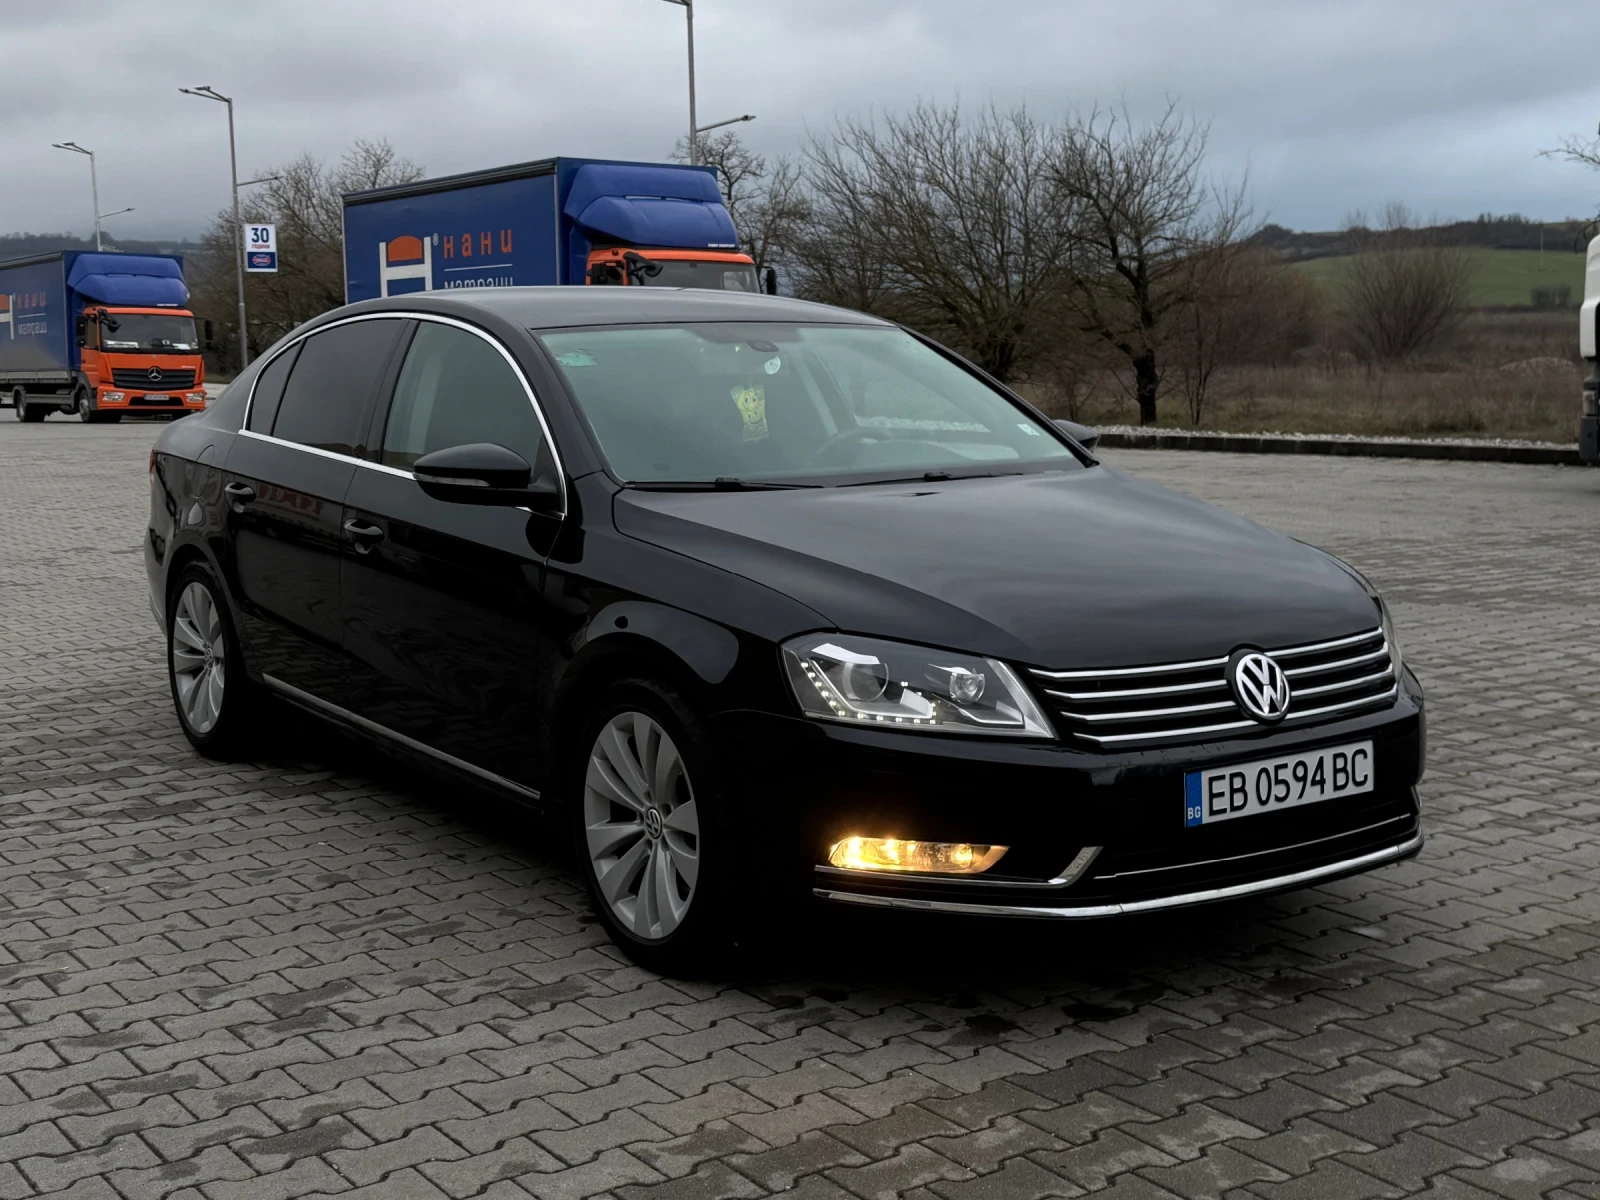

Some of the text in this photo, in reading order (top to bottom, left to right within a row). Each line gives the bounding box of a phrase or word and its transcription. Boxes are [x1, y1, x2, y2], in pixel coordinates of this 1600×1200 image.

[251, 227, 270, 243] 30
[1208, 748, 1369, 817] EB 0594 BC
[1187, 805, 1201, 820] BG
